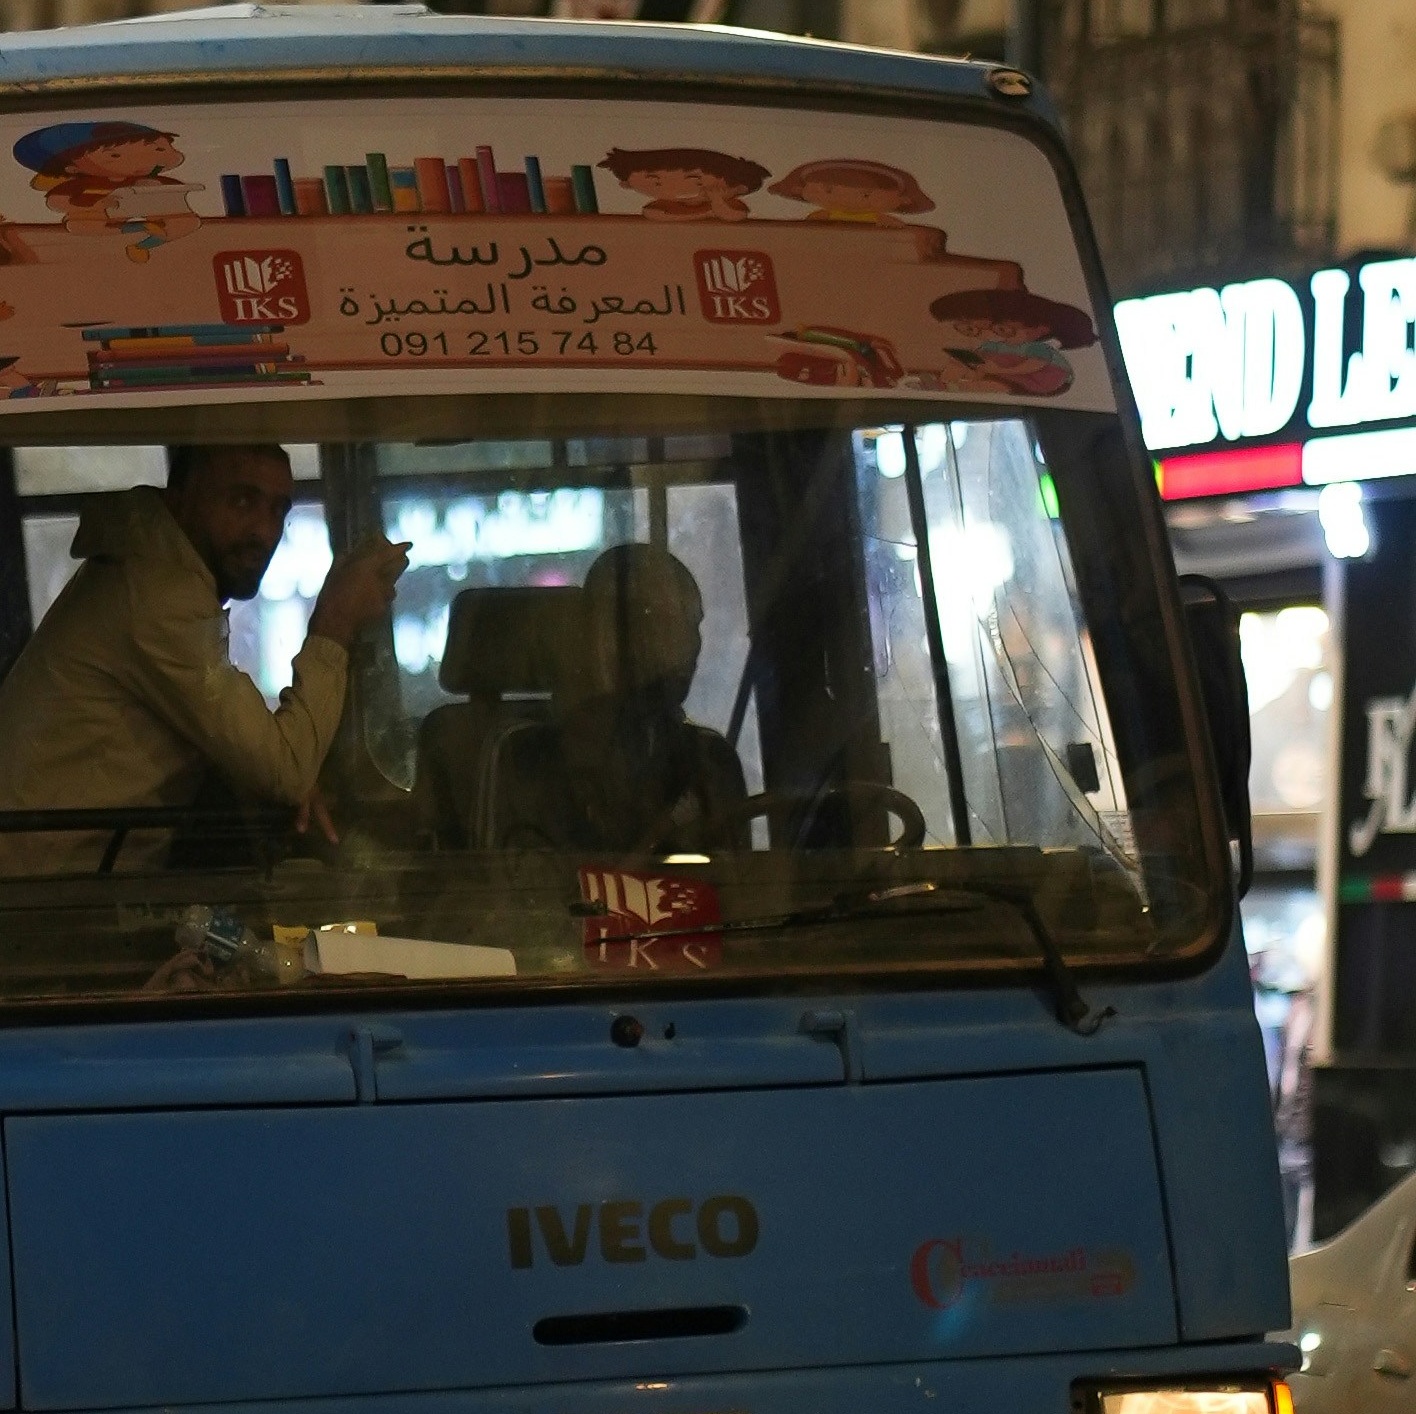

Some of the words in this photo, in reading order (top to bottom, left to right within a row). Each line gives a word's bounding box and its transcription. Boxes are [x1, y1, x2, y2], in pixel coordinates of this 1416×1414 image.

[405, 225, 609, 279] مدرسة
[235, 296, 300, 321] IKS
[339, 283, 510, 325] المتميزة
[532, 284, 686, 324] المعرفة
[712, 295, 772, 320] IKS
[380, 332, 448, 356] 091
[468, 331, 539, 355] 215
[553, 331, 598, 355] 74
[613, 331, 658, 355] 84
[508, 1195, 759, 1269] IVECO
